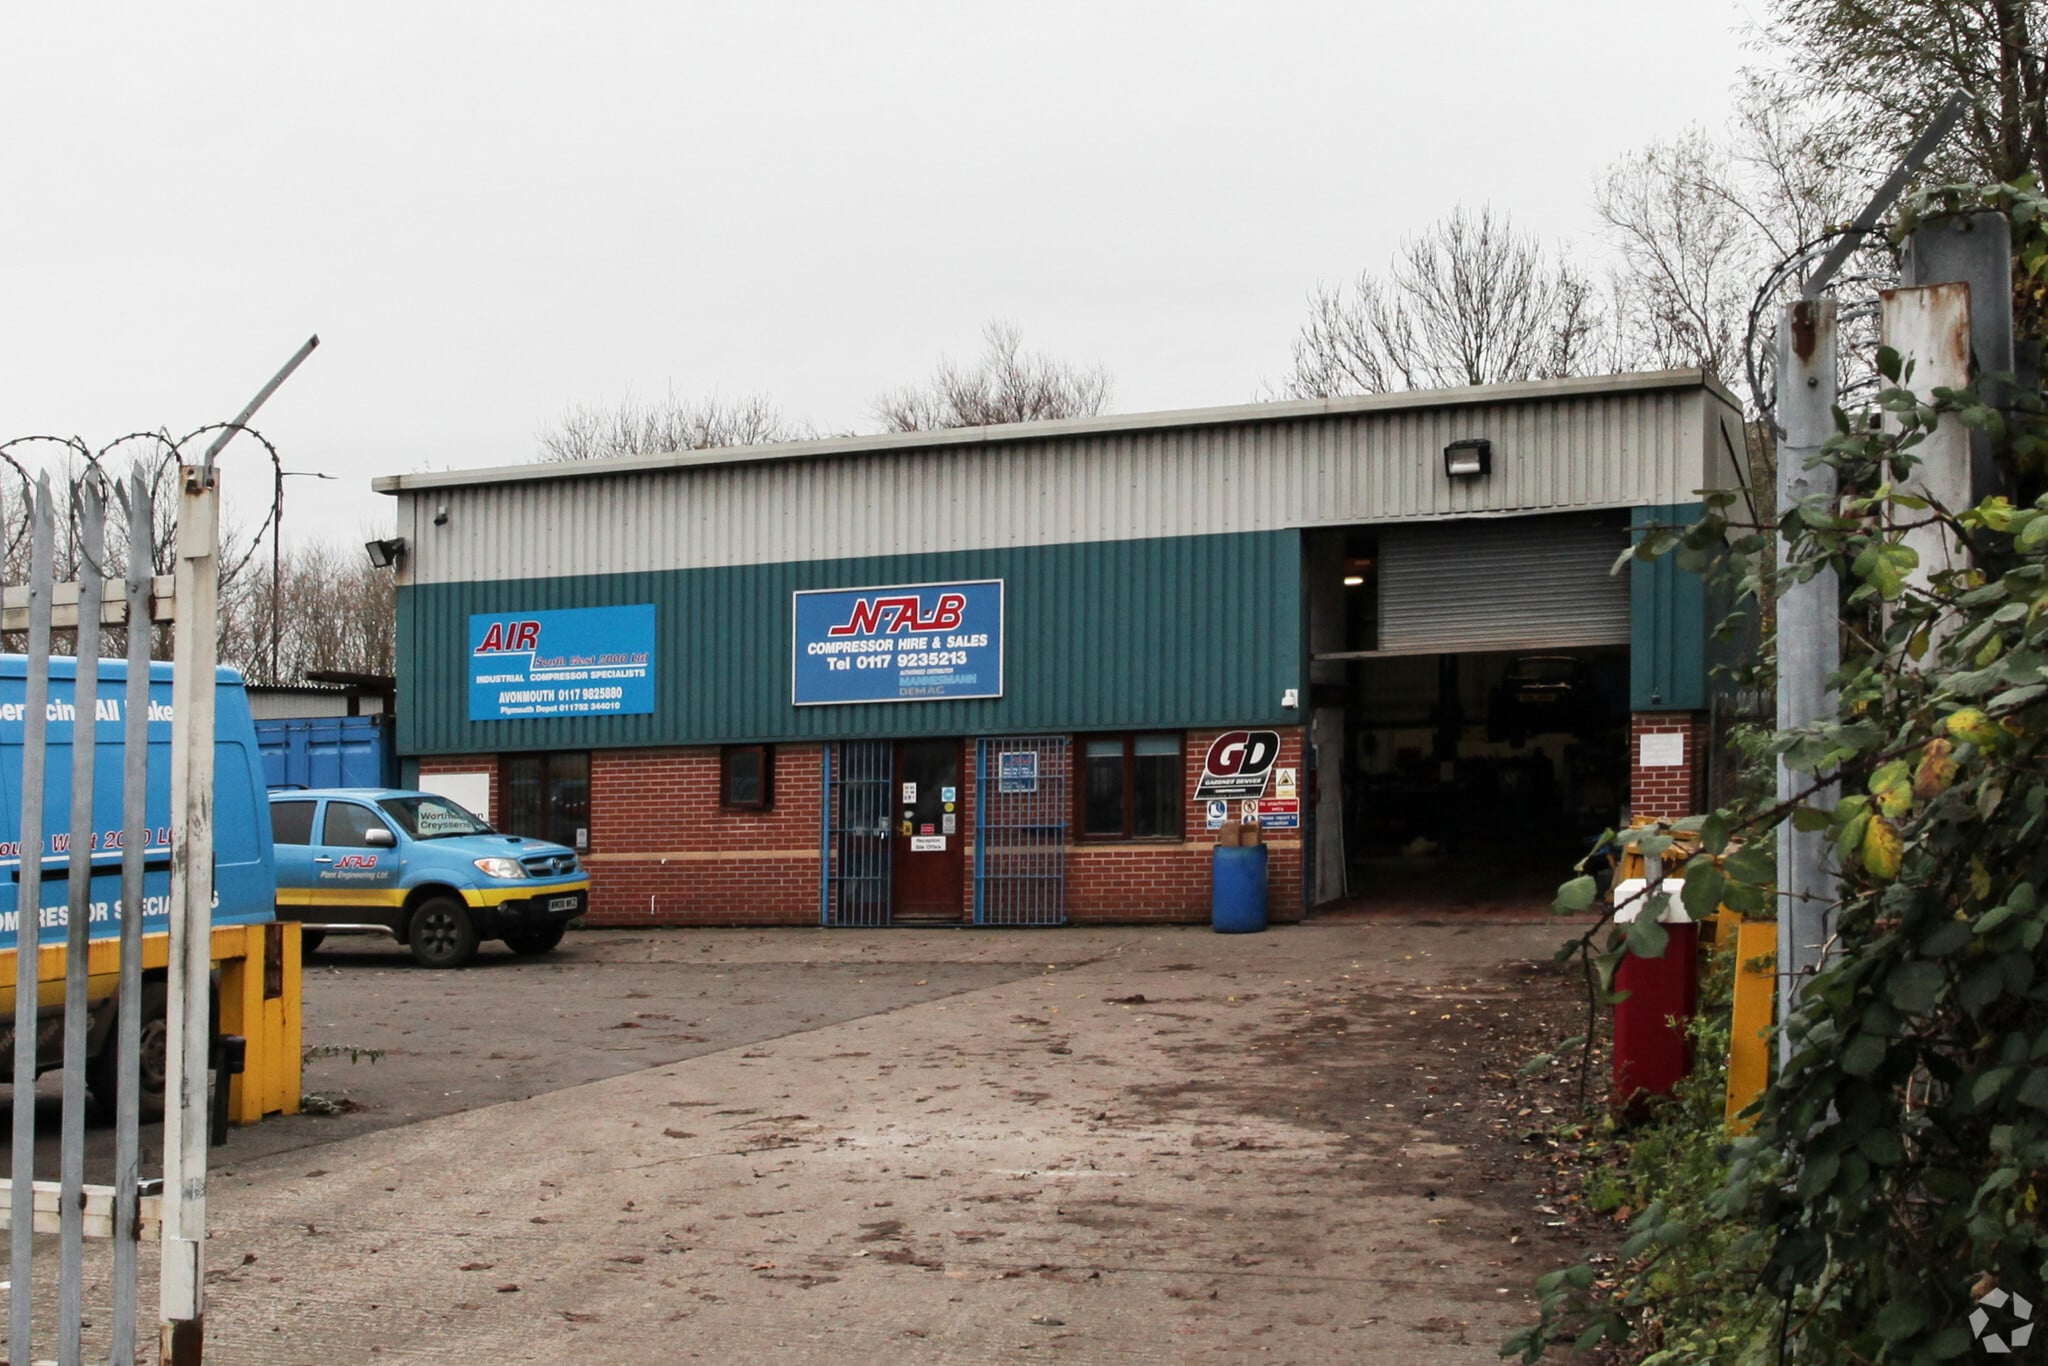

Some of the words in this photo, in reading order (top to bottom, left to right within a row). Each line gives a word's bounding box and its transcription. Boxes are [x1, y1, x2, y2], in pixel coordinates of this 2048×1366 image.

[474, 620, 541, 653] AIR
[807, 638, 894, 655] COMPRESSOR
[898, 637, 928, 650] HIRE
[932, 636, 941, 648] &
[946, 634, 988, 648] SALES
[535, 656, 566, 667] South
[570, 654, 595, 666] West
[598, 654, 627, 665] 2000
[630, 652, 648, 663] Ltd
[827, 656, 850, 671] Tel
[856, 654, 891, 669] 0117
[897, 652, 967, 667] 9235213
[476, 674, 525, 684] INDUSTRIAL
[530, 671, 589, 683] COMPRESSOR
[590, 669, 646, 680] SPECIALISTS
[499, 688, 555, 704] AVONMOUTH
[558, 687, 580, 701] 0117
[95, 698, 120, 721] All
[500, 705, 534, 715] Plymouth
[536, 704, 558, 714] Depot
[1206, 730, 1280, 777] GD
